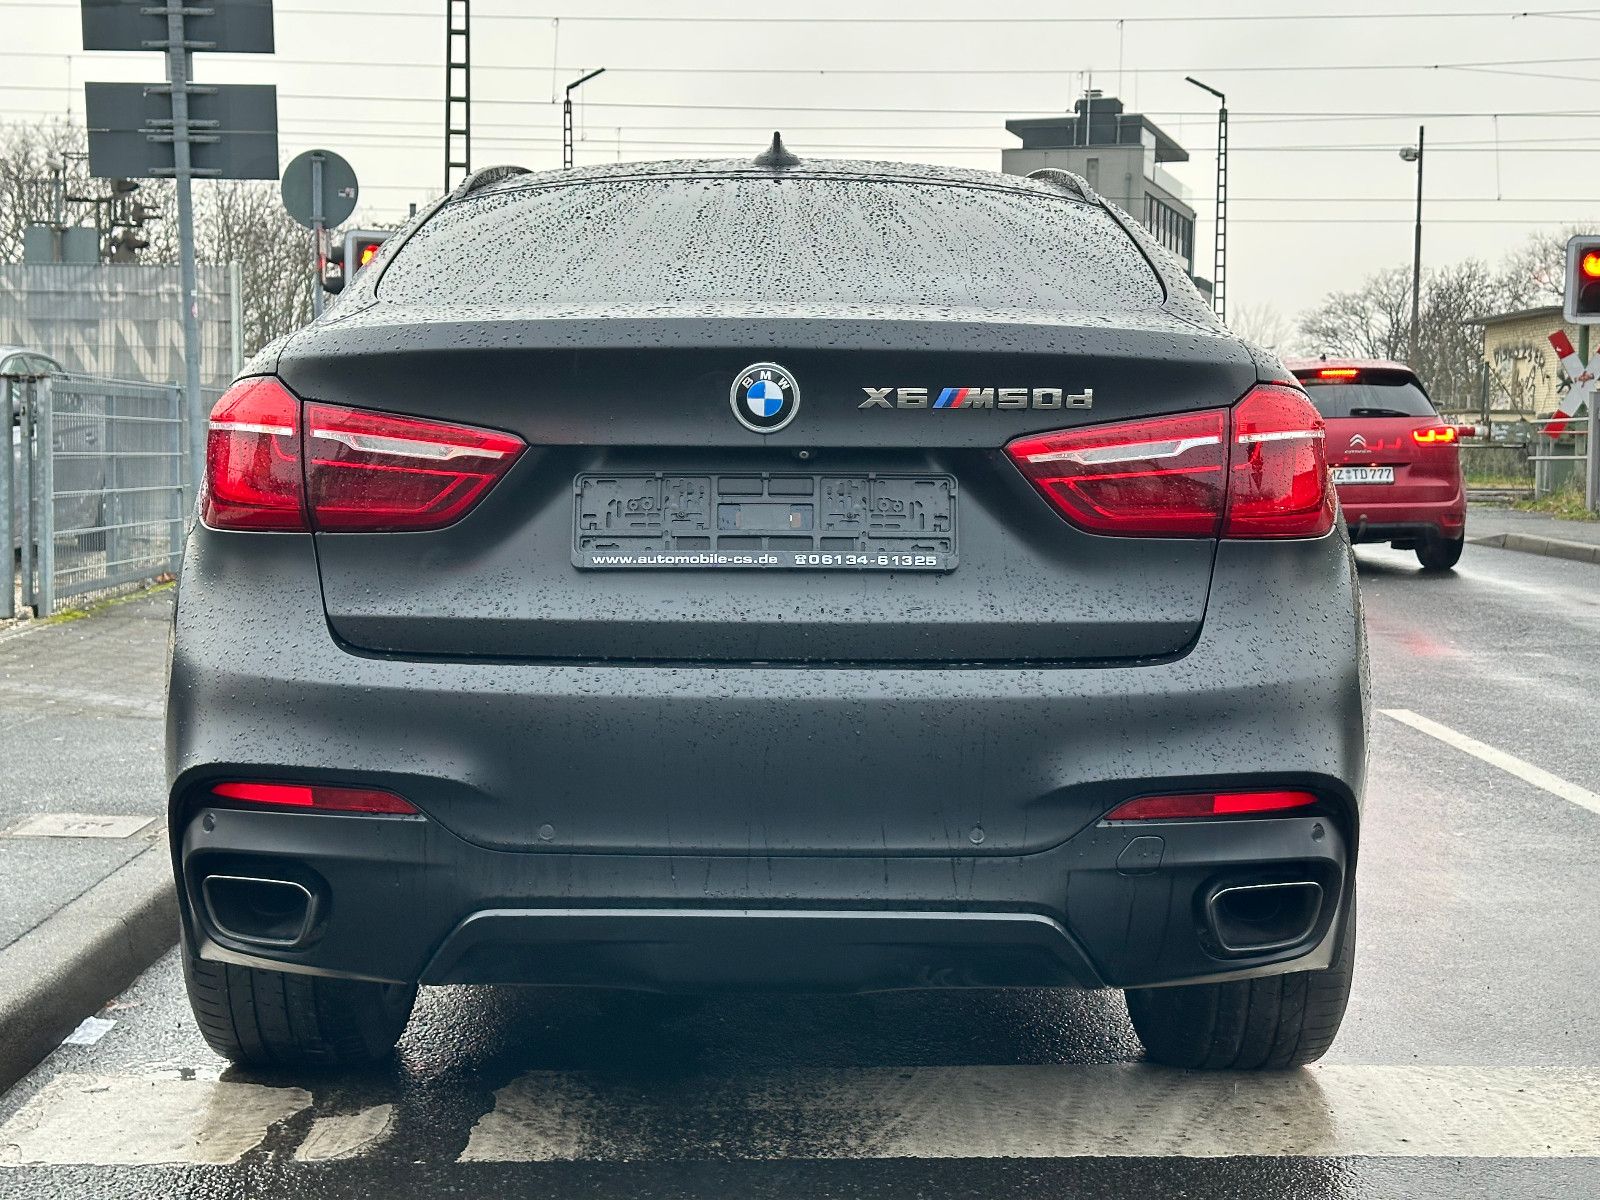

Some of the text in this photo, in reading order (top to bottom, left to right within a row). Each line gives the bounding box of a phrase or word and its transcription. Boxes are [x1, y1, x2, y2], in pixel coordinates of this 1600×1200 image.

[741, 370, 791, 390] BMW
[857, 387, 1093, 410] X6 M50d
[592, 553, 778, 565] www.automobile-cs.de
